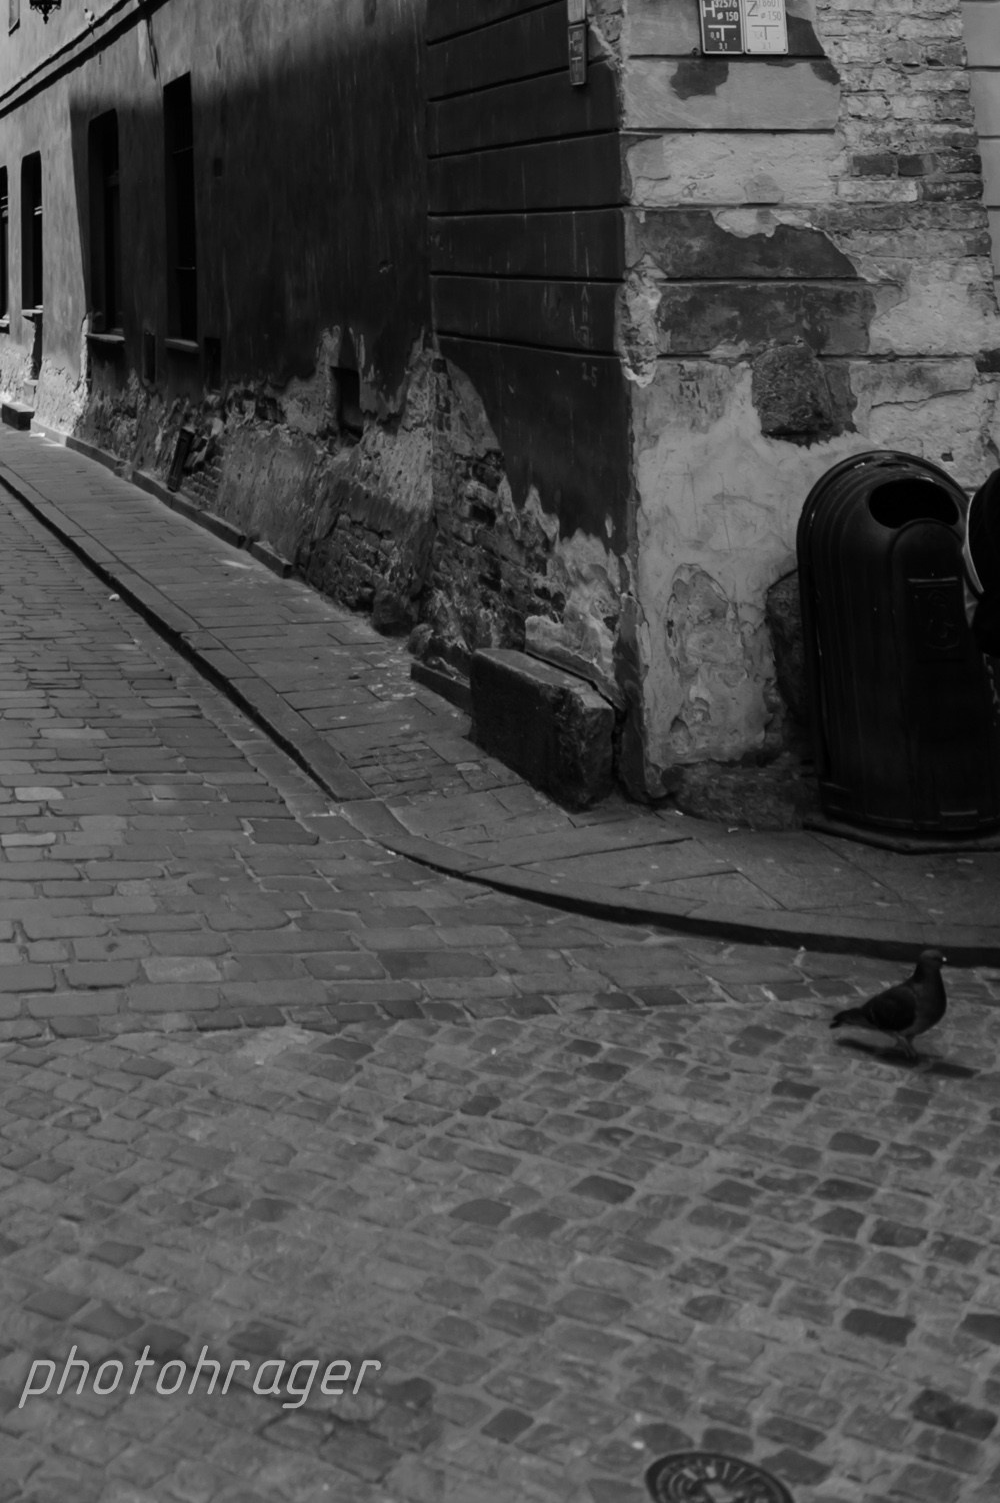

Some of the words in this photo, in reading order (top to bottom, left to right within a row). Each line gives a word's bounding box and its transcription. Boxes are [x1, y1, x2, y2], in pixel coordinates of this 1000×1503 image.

[702, 0, 716, 18] H
[745, 0, 759, 17] Z
[767, 10, 782, 21] 150
[725, 10, 739, 22] 150
